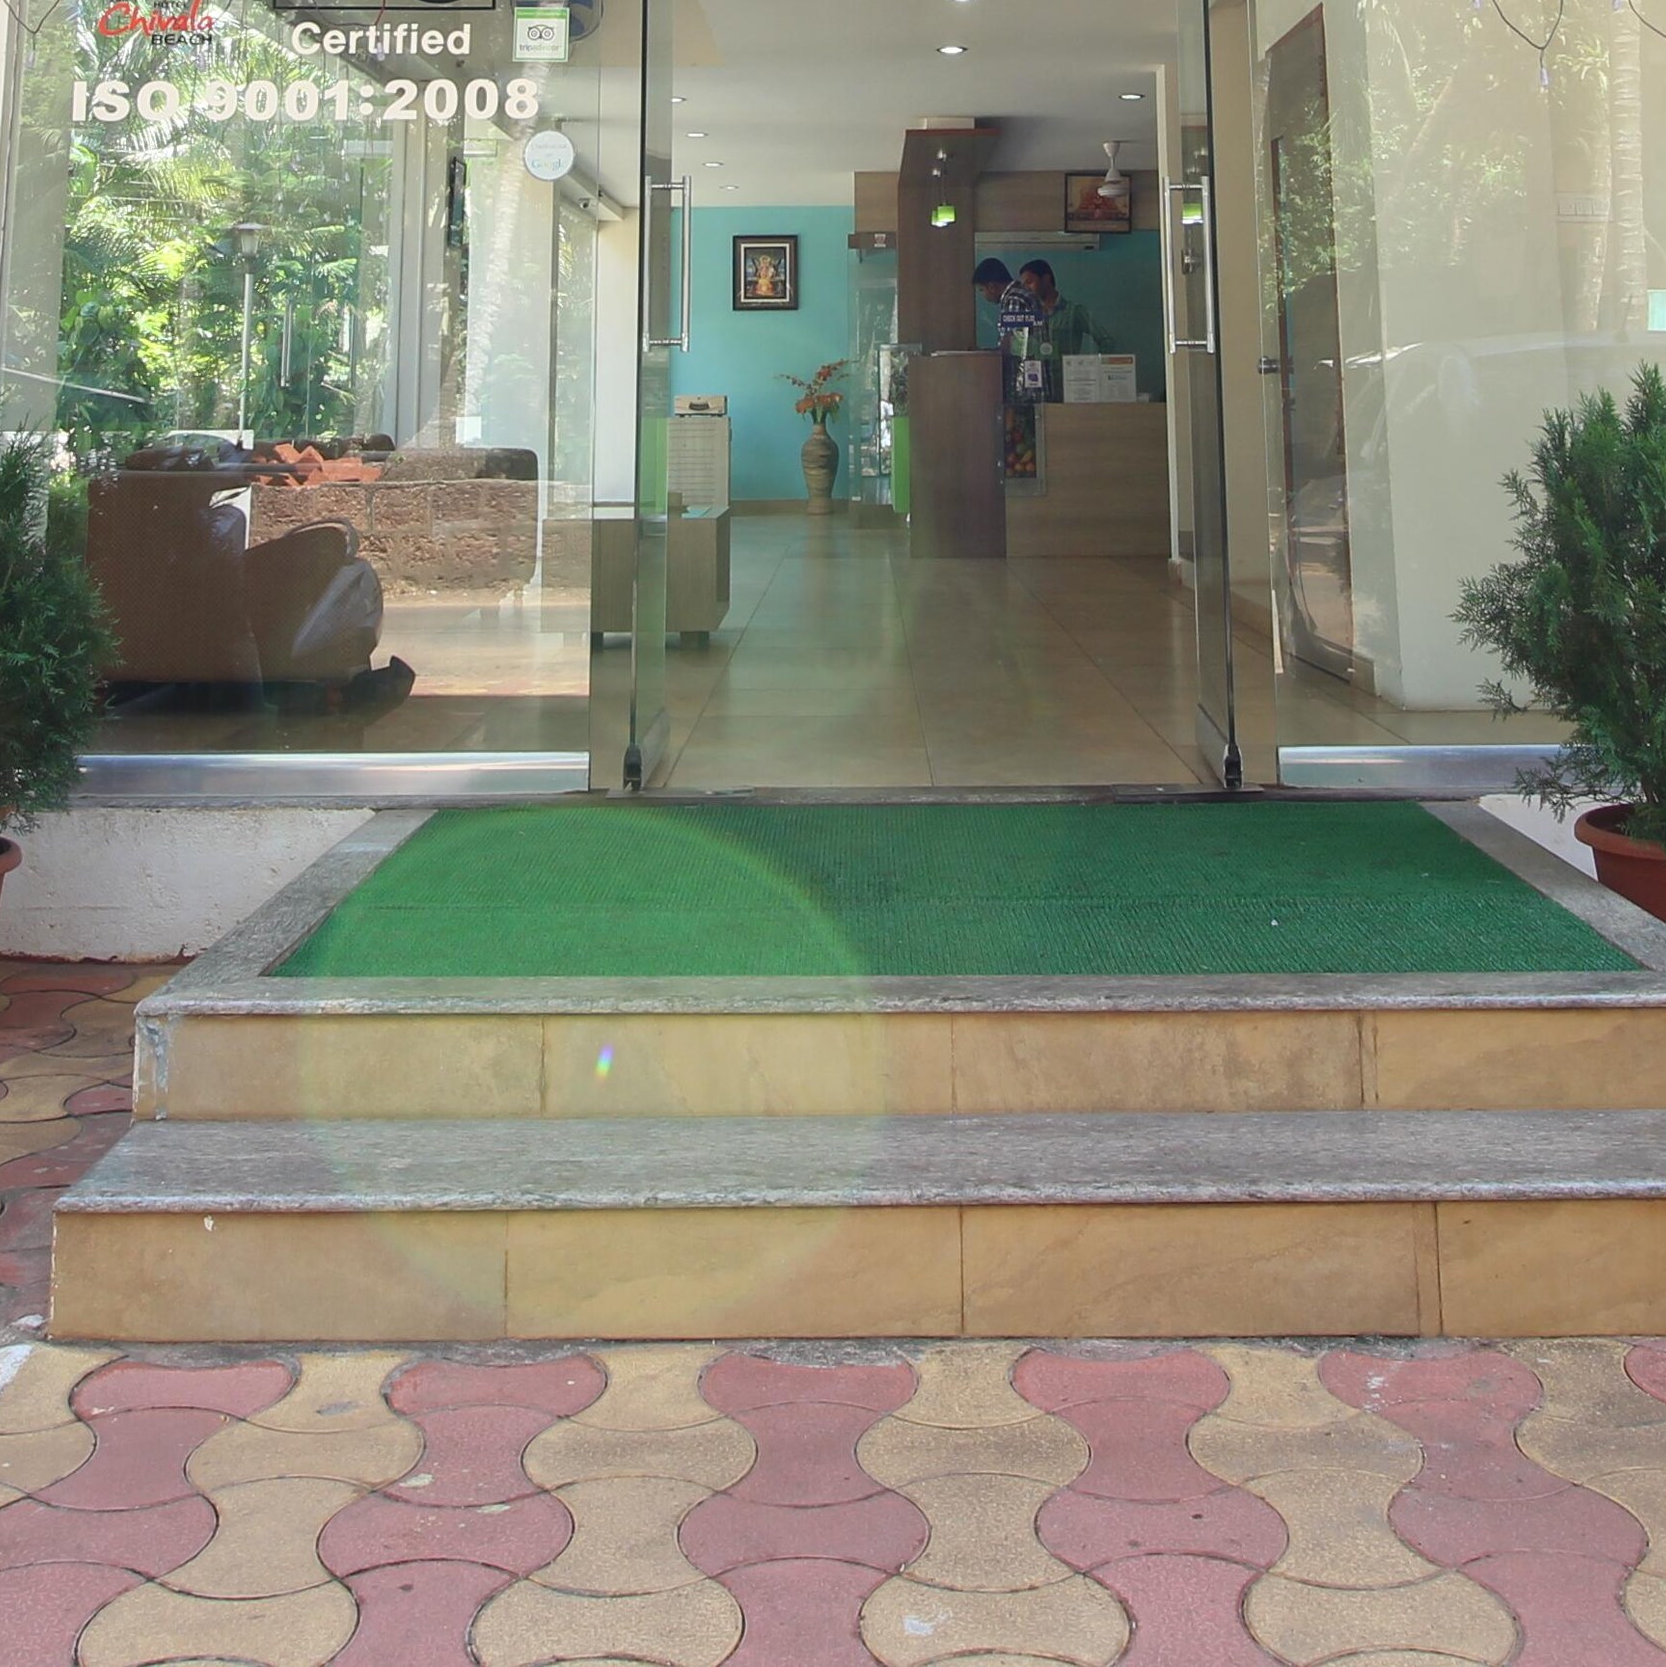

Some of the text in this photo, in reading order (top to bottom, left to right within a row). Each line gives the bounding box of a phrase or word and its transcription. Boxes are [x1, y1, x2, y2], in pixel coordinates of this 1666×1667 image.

[151, 33, 213, 46] BEACH
[291, 21, 471, 55] Certified
[71, 78, 539, 123] ISO 9001:2008
